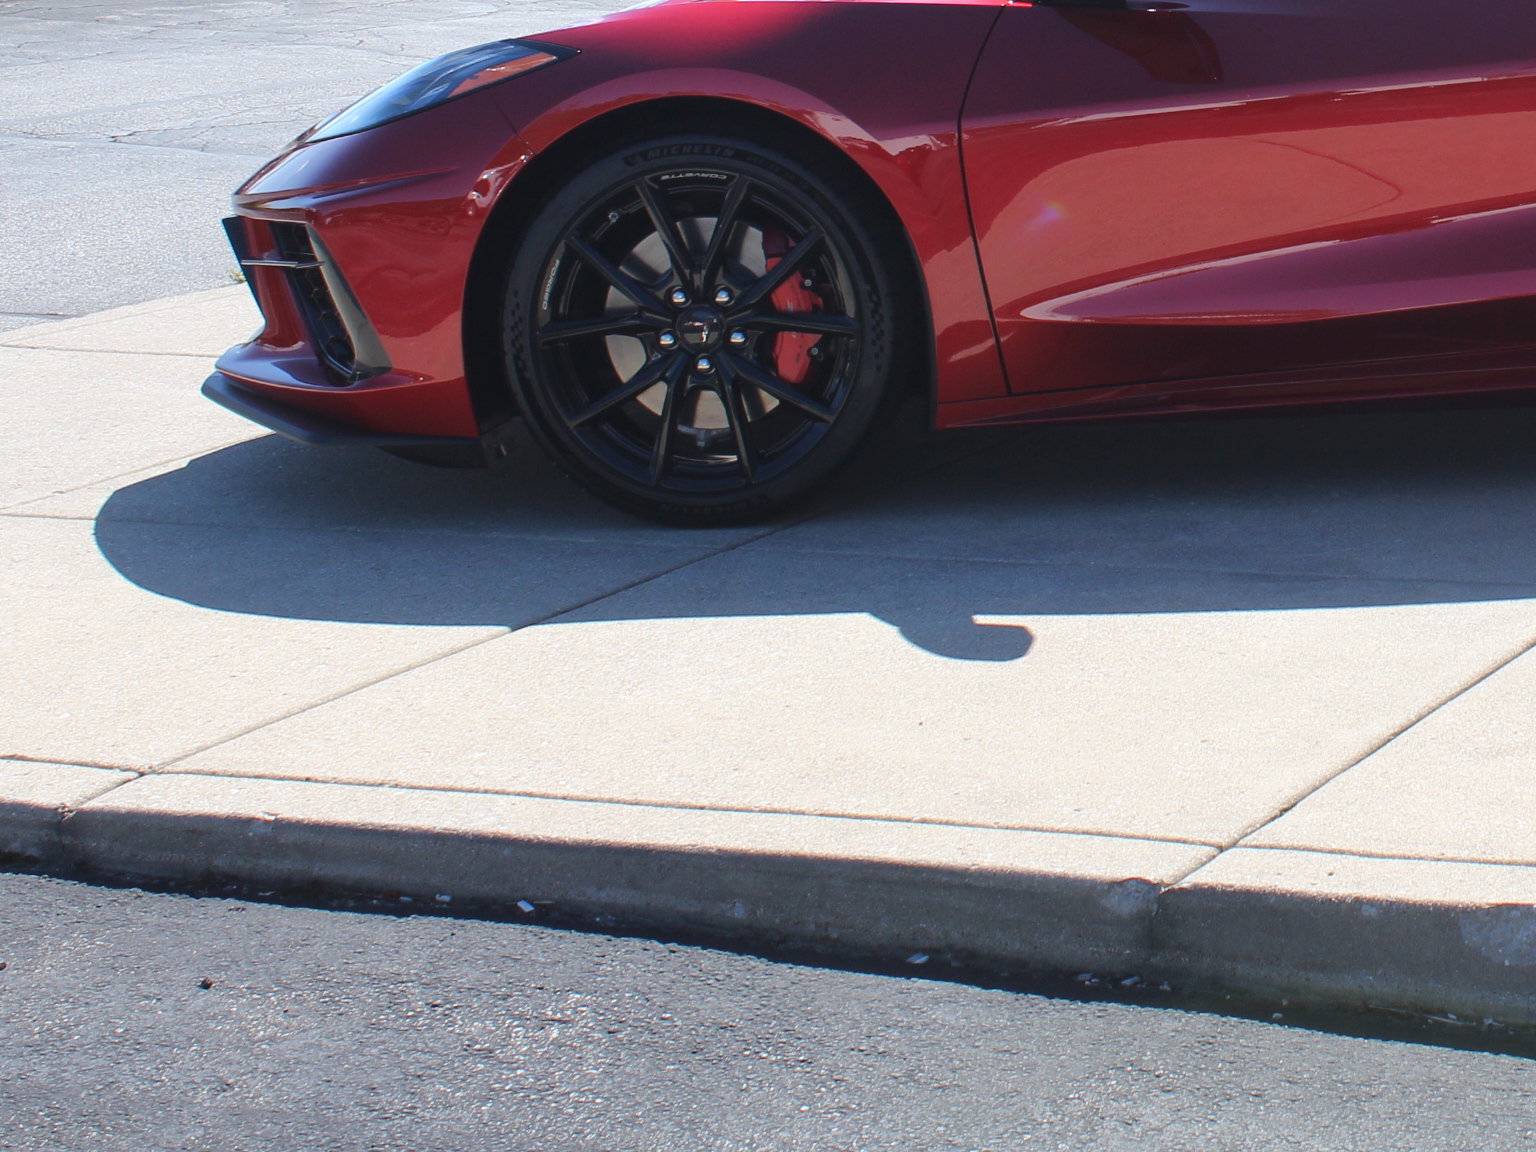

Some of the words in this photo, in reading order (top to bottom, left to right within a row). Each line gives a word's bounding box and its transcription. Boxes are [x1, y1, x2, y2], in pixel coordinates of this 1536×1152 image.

[646, 143, 735, 160] MICHELIN
[660, 172, 728, 181] CORVETTE
[542, 258, 560, 311] FORGED
